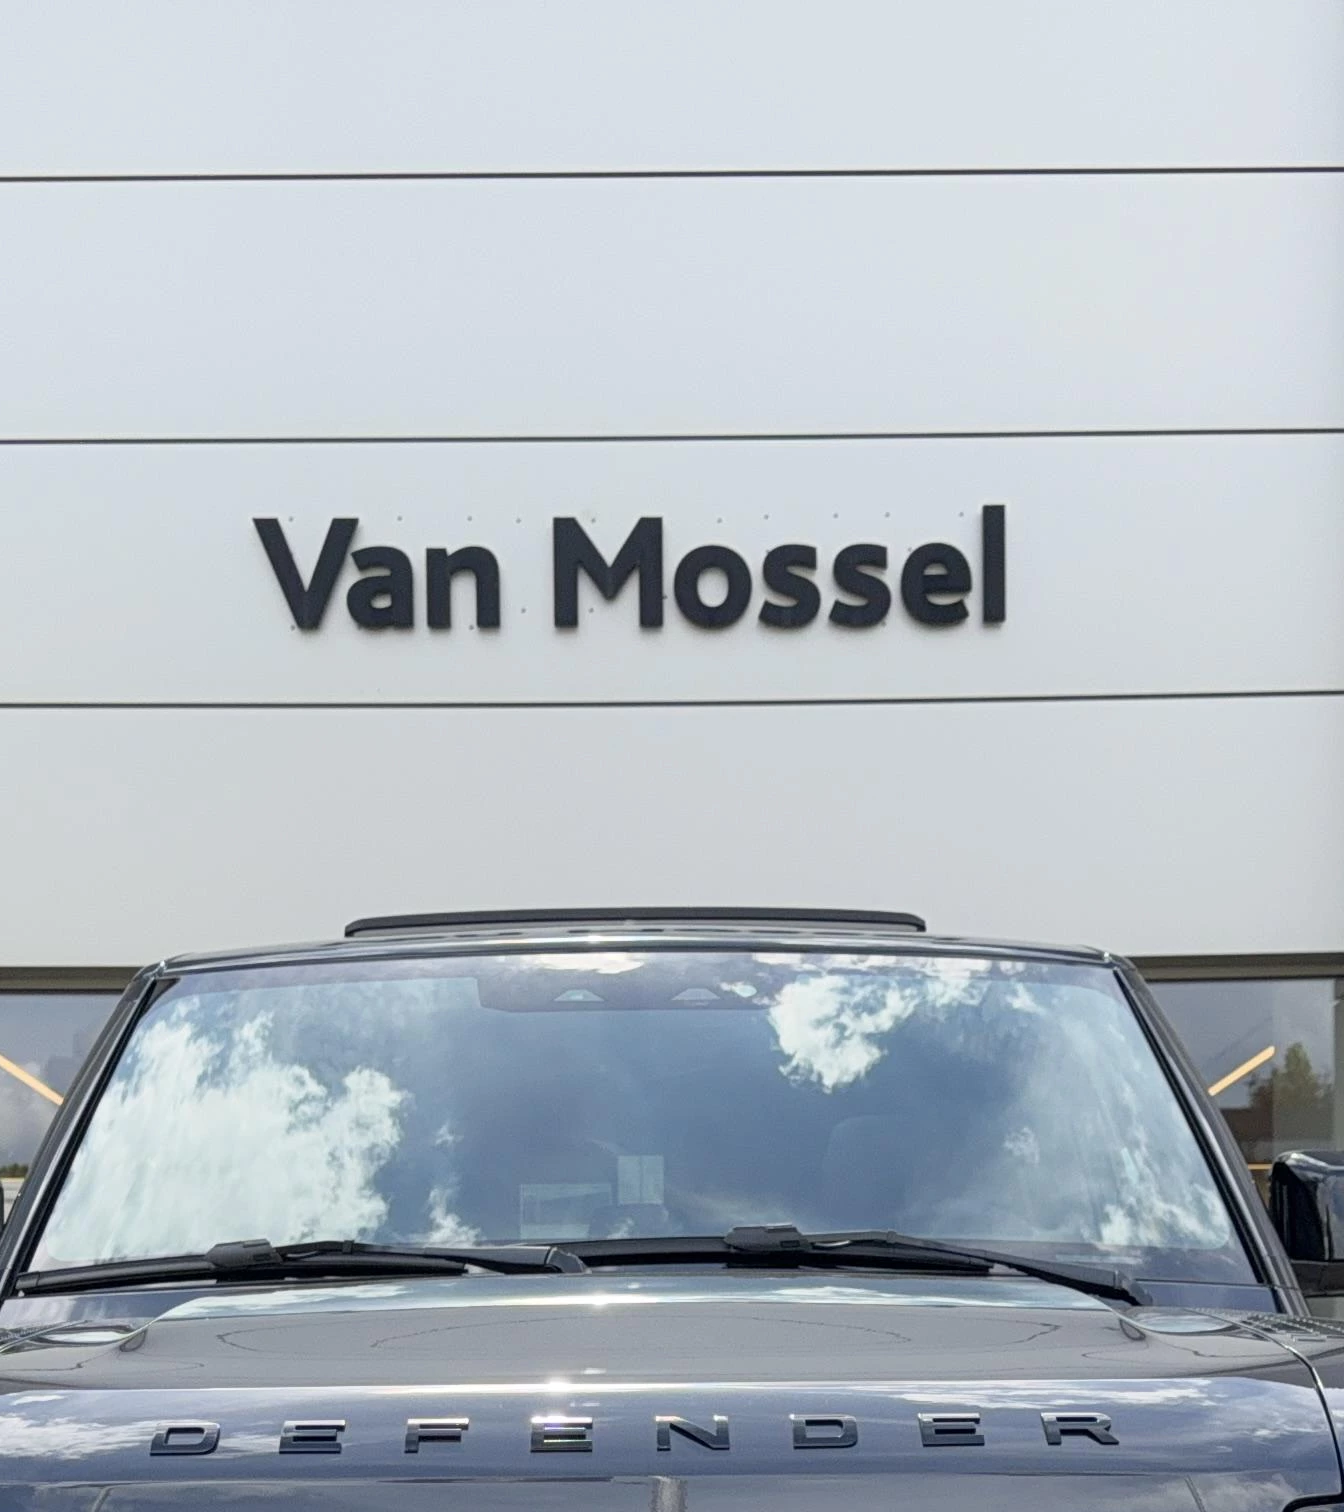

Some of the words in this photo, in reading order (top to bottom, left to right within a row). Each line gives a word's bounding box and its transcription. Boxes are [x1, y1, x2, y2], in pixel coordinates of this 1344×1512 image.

[253, 517, 500, 632] Van
[553, 505, 1005, 632] Mossel
[149, 1410, 1120, 1457] DEFENDER
